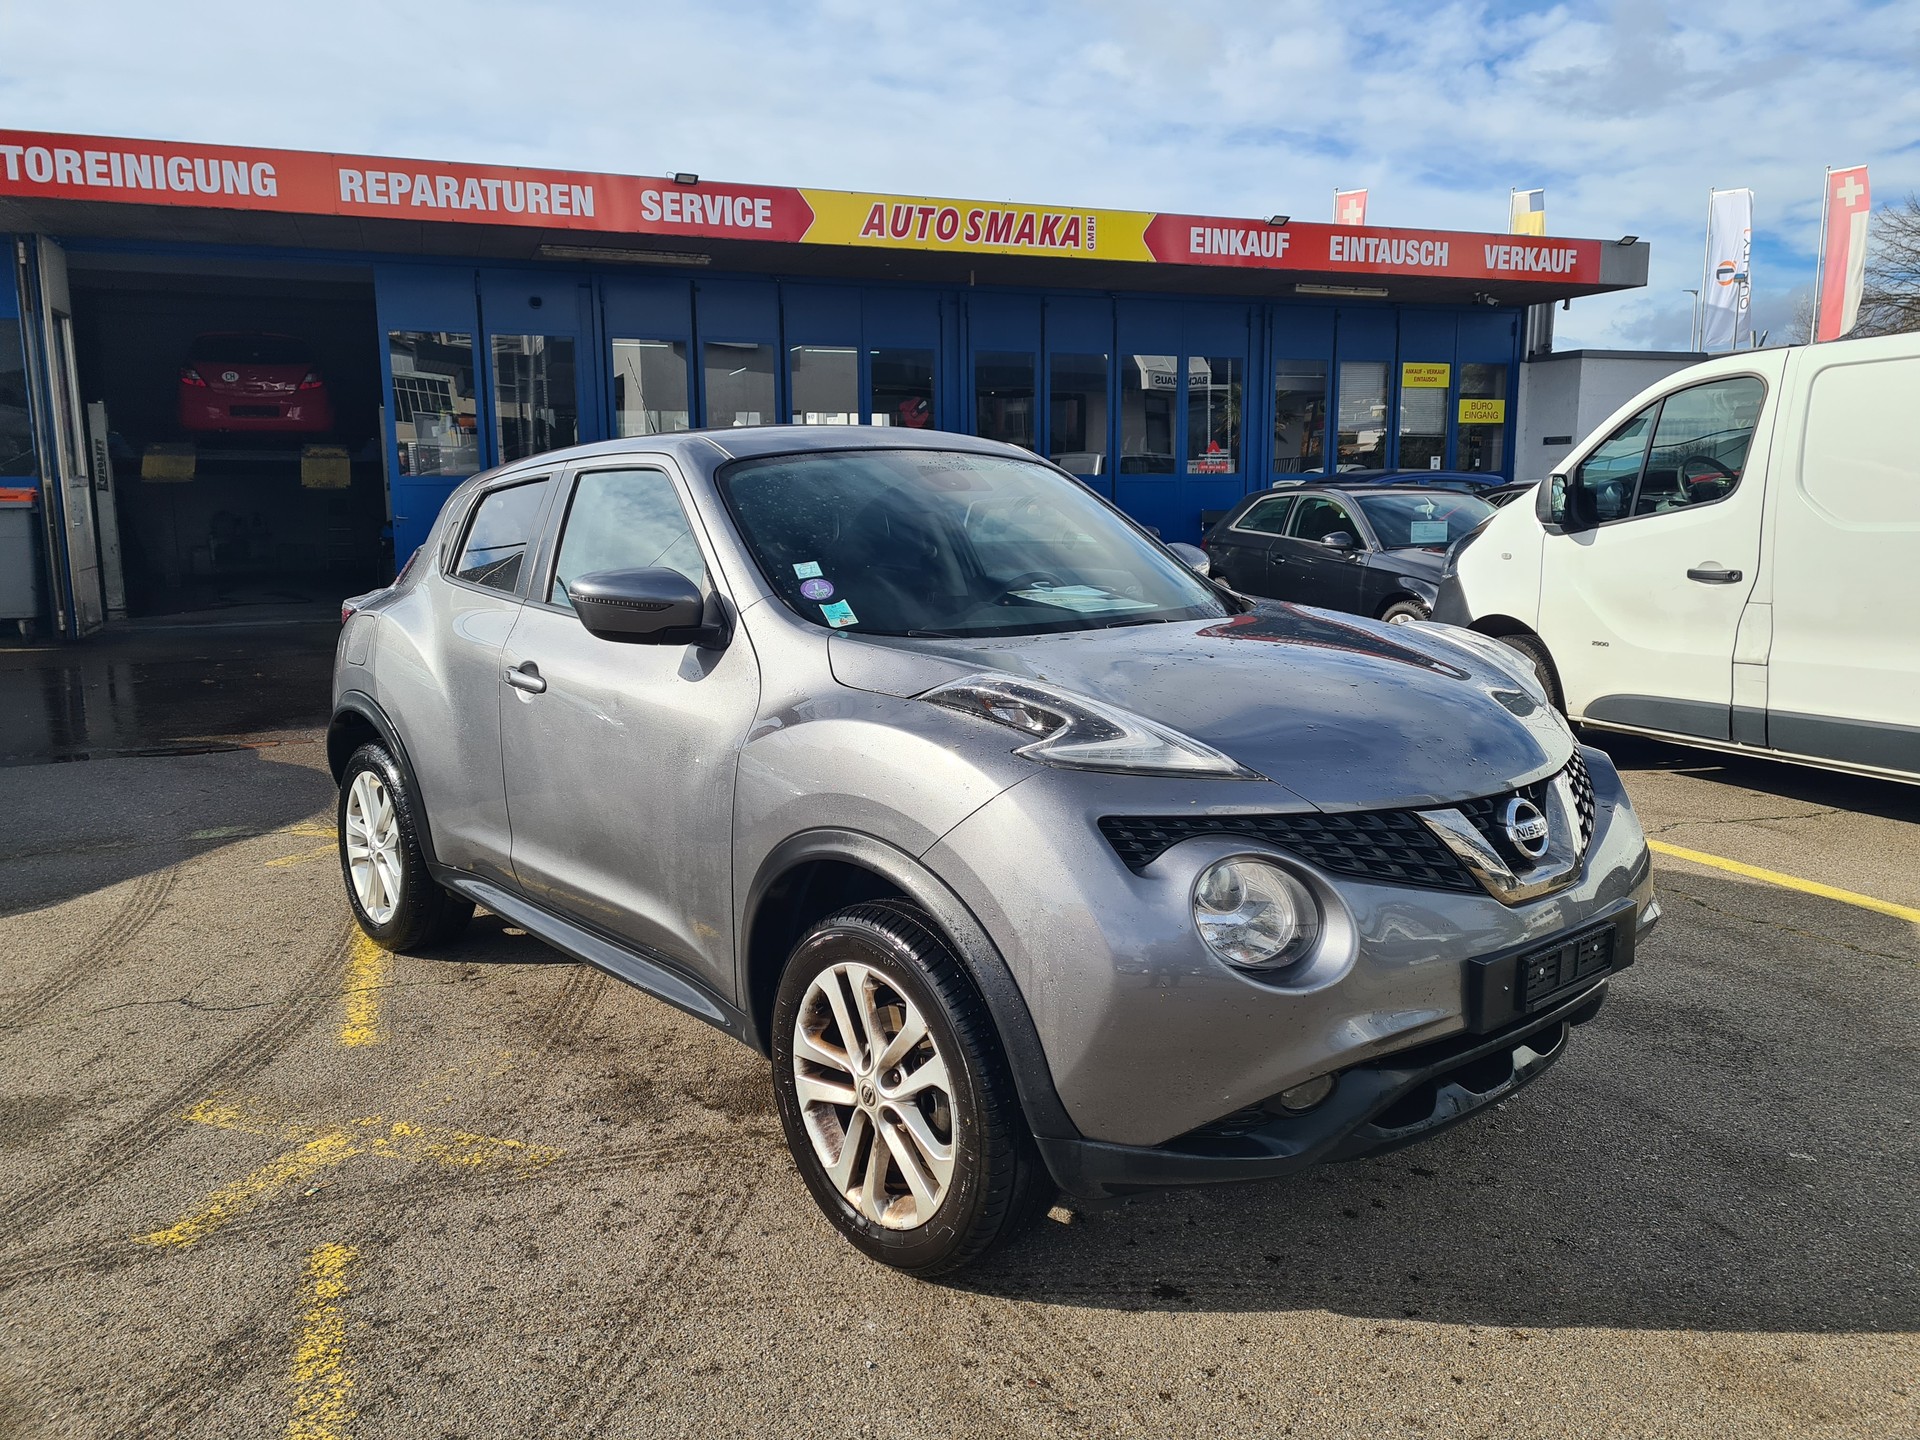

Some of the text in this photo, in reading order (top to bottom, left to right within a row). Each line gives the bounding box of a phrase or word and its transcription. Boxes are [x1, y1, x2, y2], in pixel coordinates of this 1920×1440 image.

[0, 145, 278, 197] TOREINIGUNG
[338, 169, 594, 217] REPARATUREN
[641, 190, 772, 229] SERVICE
[1087, 216, 1096, 250] GMBH
[1189, 226, 1290, 259] EINKAUF
[1329, 235, 1449, 268] EINTAUSCH
[1484, 244, 1577, 274] VERKAUF
[1464, 411, 1499, 420] EINGANG
[1470, 401, 1493, 410] BÜRO
[1591, 640, 1610, 648] 2900
[1515, 821, 1549, 839] NISSAN
